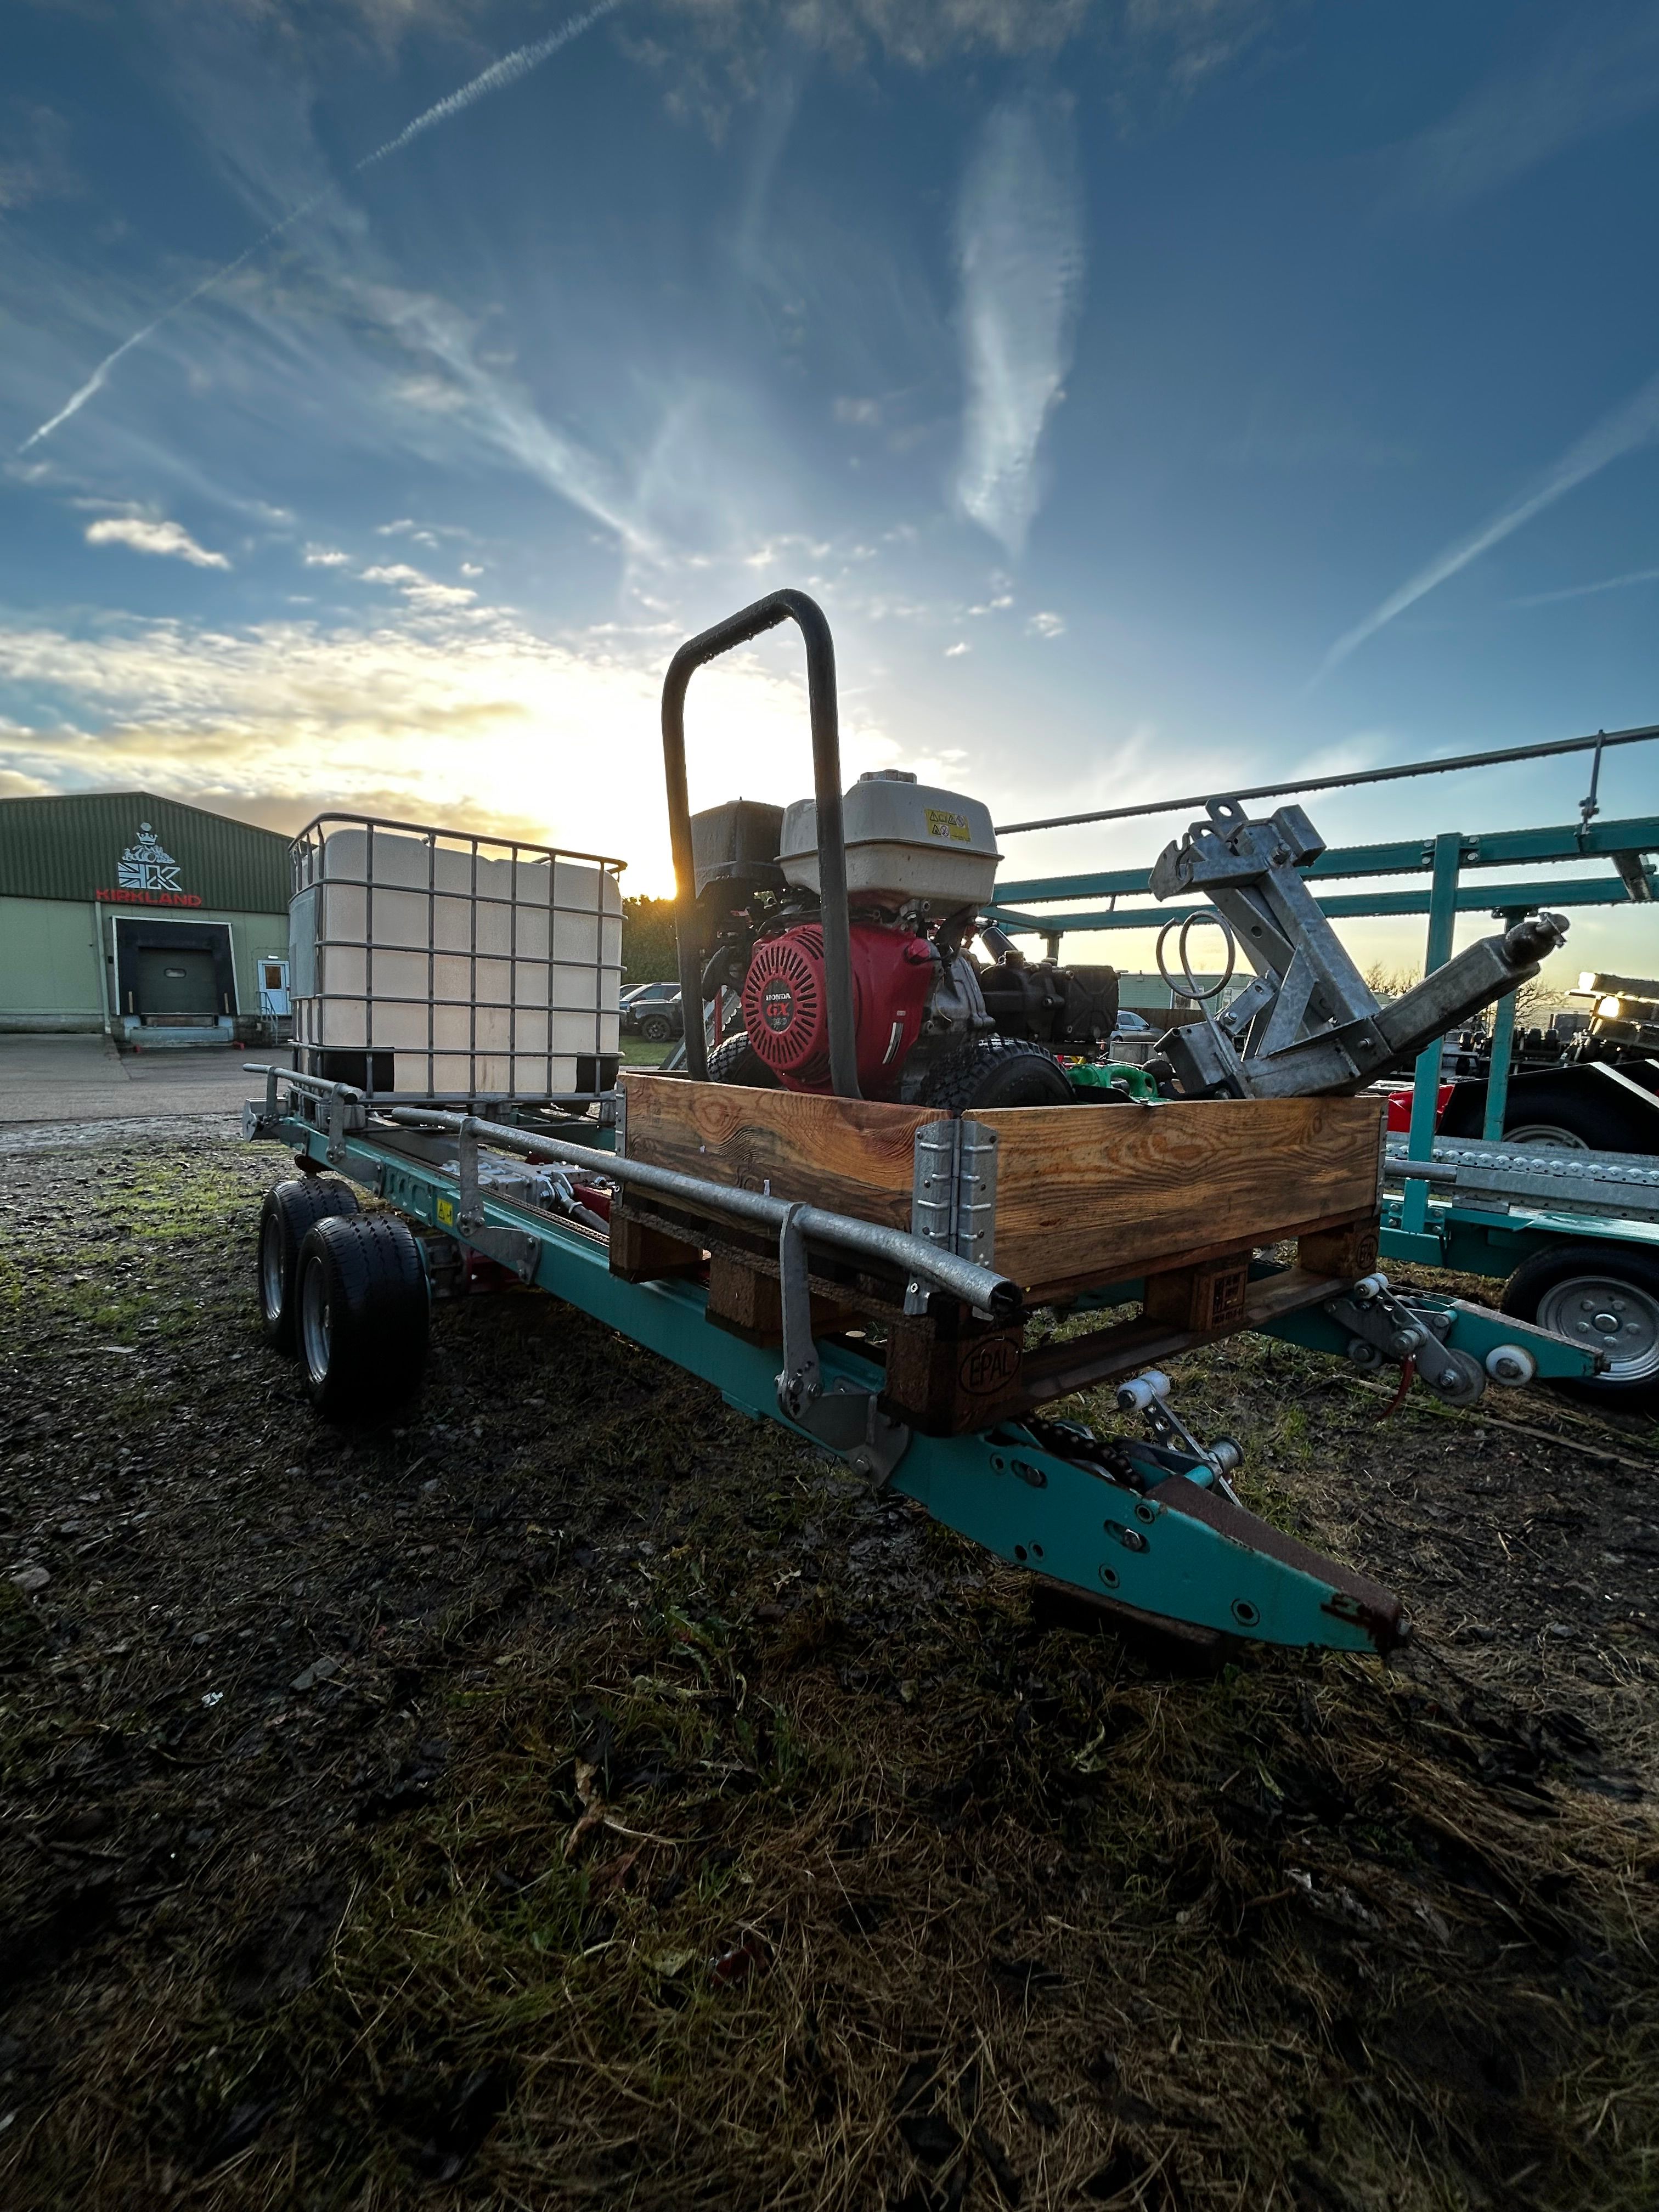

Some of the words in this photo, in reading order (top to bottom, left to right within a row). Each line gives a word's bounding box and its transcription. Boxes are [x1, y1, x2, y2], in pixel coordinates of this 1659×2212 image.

[95, 888, 202, 906] KIRKLAND
[765, 992, 792, 1001] HONDA
[766, 1002, 790, 1017] GX
[970, 1348, 1011, 1387] EPAL
